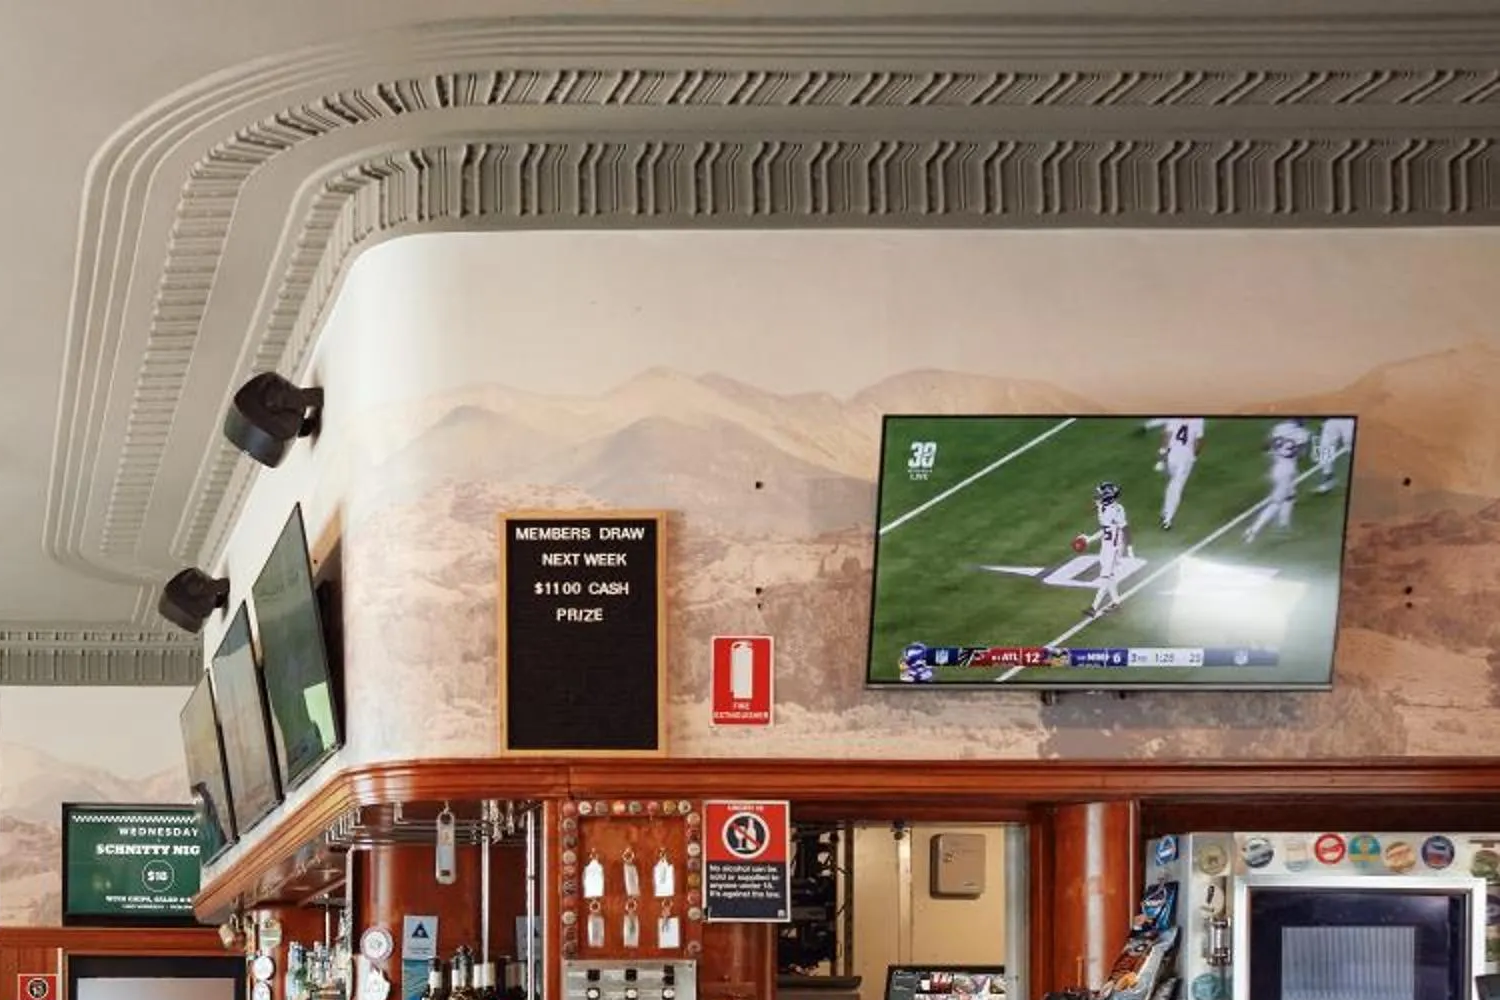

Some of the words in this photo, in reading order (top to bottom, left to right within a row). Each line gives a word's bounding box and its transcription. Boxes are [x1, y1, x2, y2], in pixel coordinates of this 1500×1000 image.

[1175, 425, 1189, 445] 4
[515, 527, 591, 541] MEMBERS
[600, 527, 645, 541] DRAW
[541, 553, 580, 567] NEXT
[584, 553, 628, 567] WEEK
[533, 581, 582, 596] $1100
[588, 582, 629, 596] CASH
[556, 607, 604, 622] PRIZE
[1025, 652, 1040, 663] 12
[118, 827, 199, 837] WEDNESDAY
[96, 843, 171, 855] SCHNITTY
[173, 845, 201, 855] NIG
